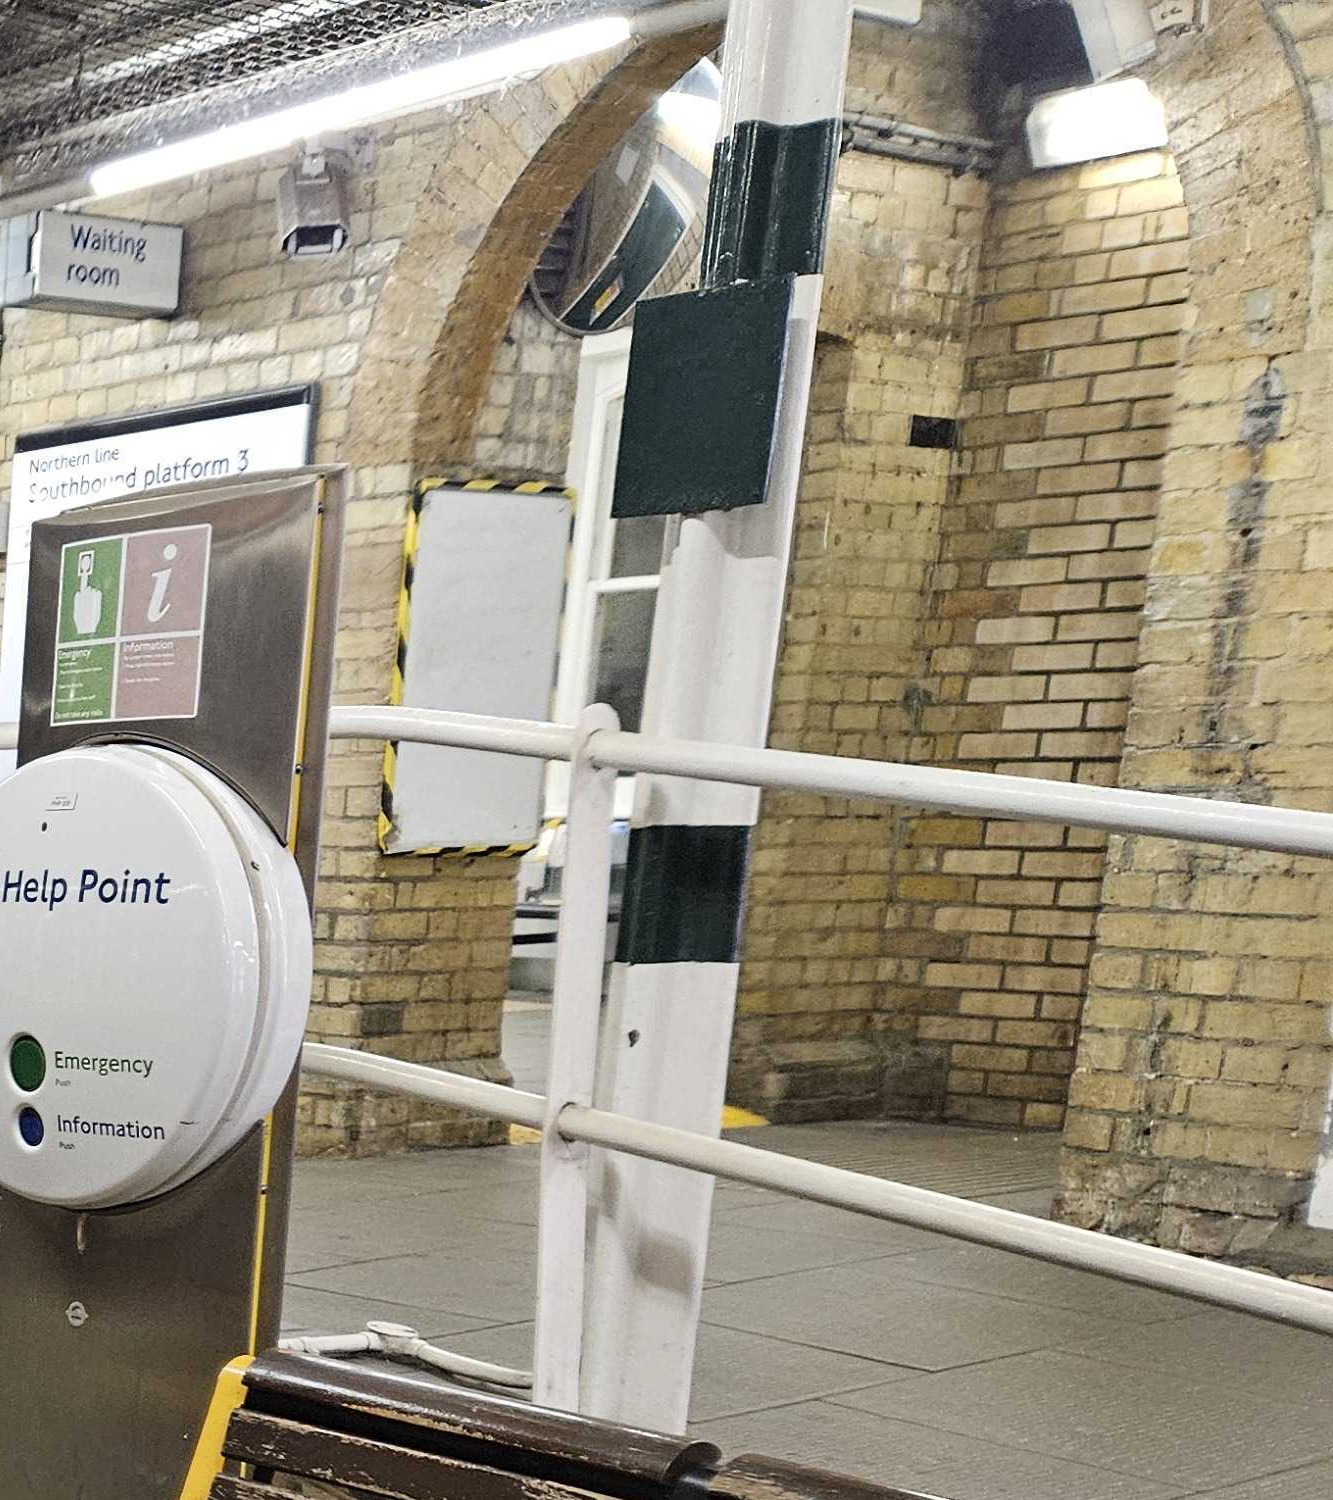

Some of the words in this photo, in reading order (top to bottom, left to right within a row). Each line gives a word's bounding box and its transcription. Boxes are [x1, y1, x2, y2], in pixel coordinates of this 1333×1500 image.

[70, 223, 147, 263] Waiting
[67, 264, 119, 286] room
[29, 451, 90, 474] Northern
[94, 447, 120, 464] line
[142, 455, 230, 491] platform
[236, 447, 250, 474] 3
[2, 868, 68, 911] Help
[78, 868, 171, 904] Point
[54, 1050, 153, 1078] Emergency
[55, 1078, 71, 1087] Push
[57, 1114, 166, 1140] Information
[59, 1141, 76, 1150] Push
